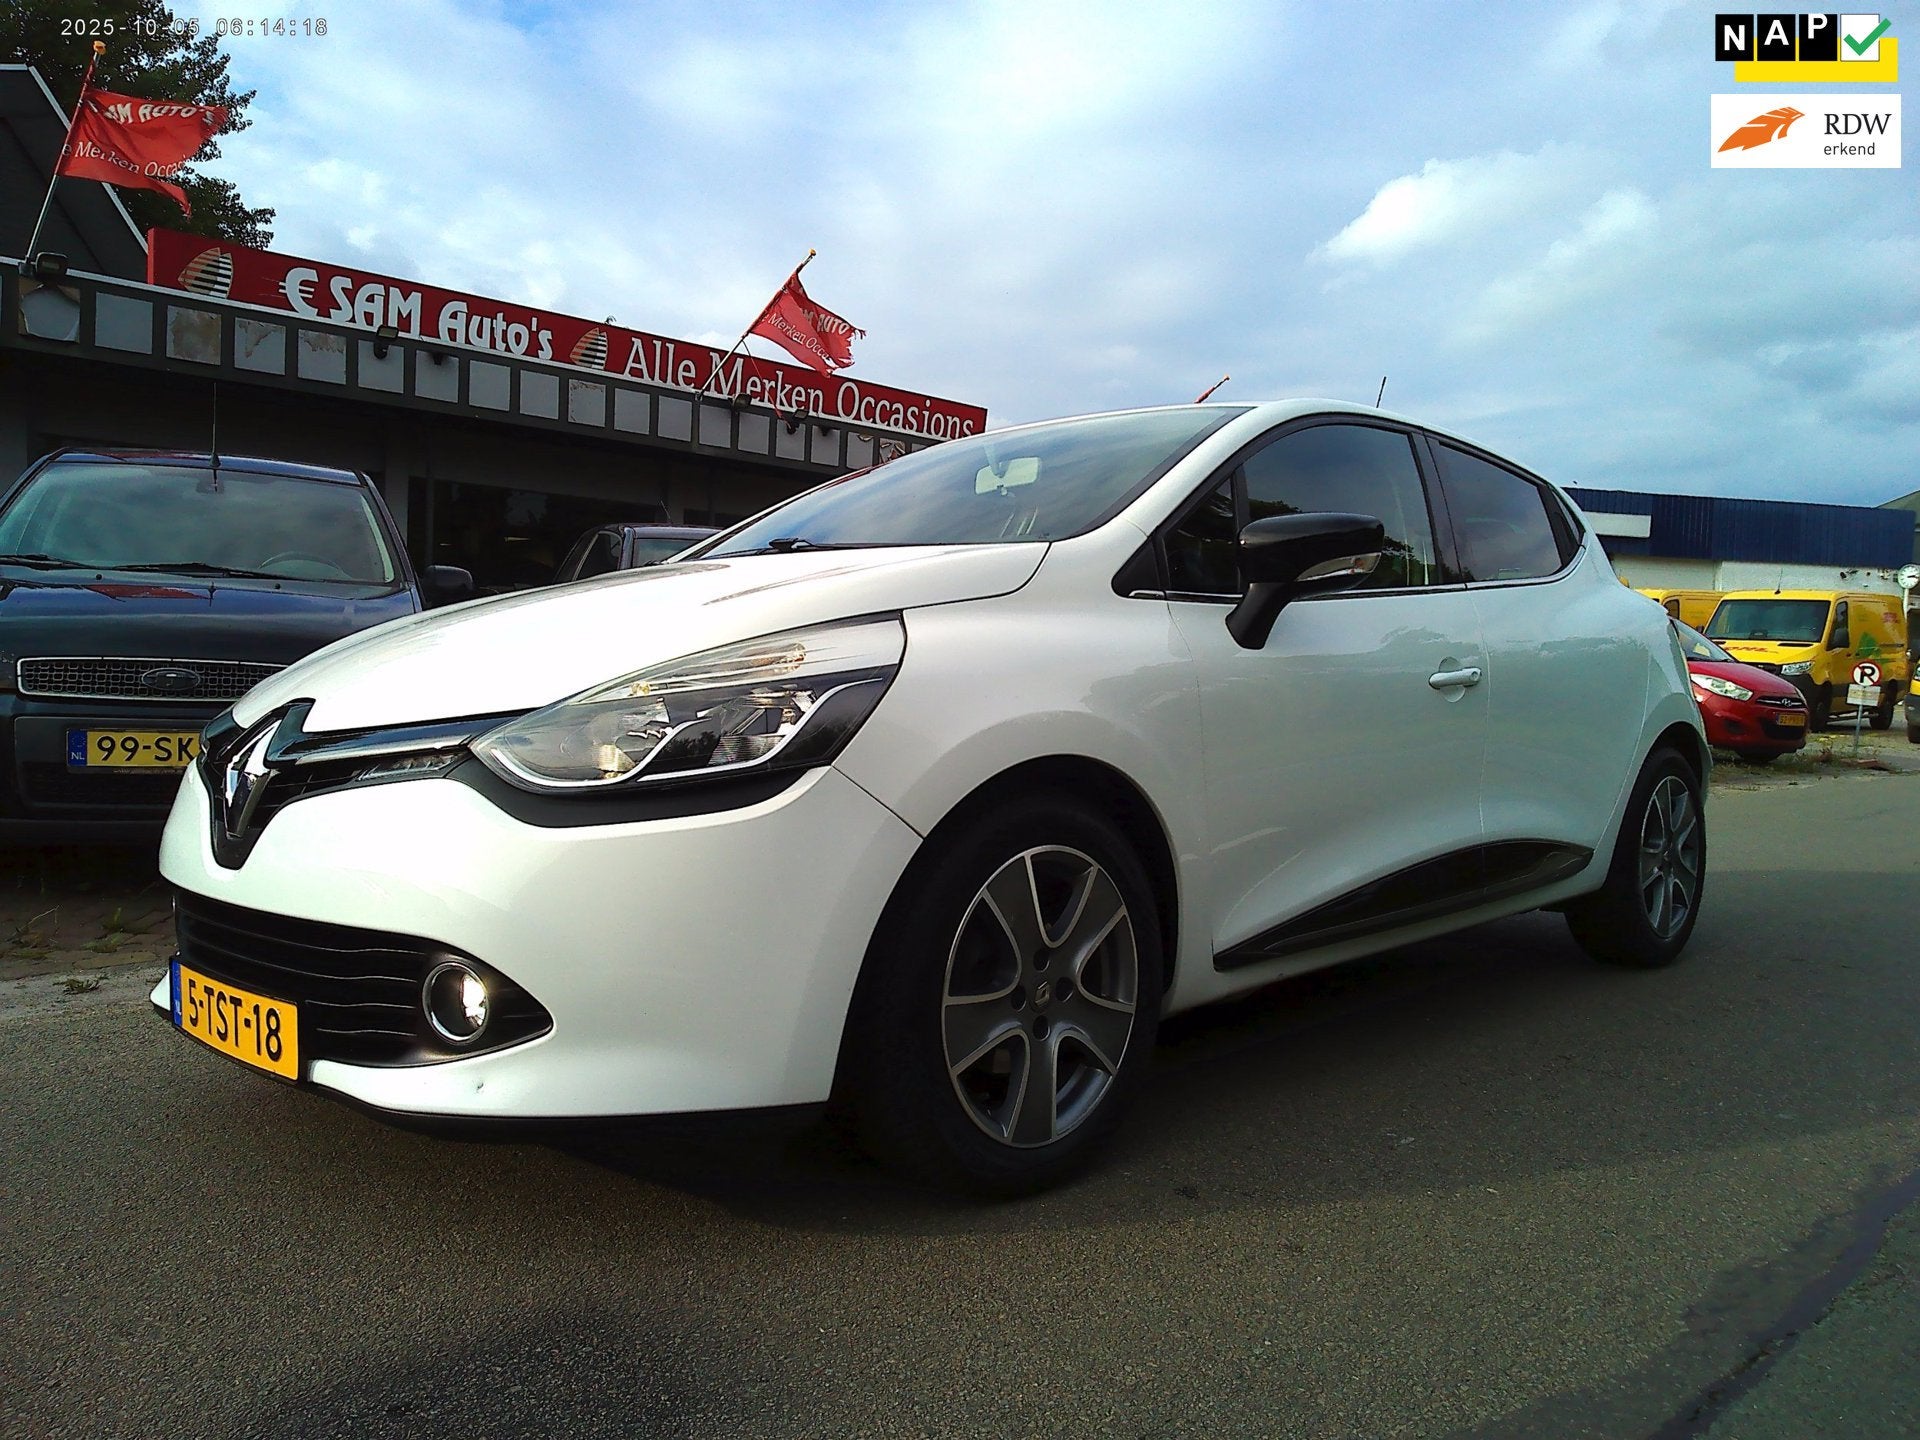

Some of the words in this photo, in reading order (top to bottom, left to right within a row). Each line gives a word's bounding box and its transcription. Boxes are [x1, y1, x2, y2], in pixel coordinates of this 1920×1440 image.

[329, 275, 422, 339] SAM
[438, 300, 553, 361] Auto's
[623, 336, 698, 388] Alle
[709, 350, 826, 416] Merken
[836, 381, 975, 443] Occasions
[188, 978, 284, 1063] 5-TST-18
